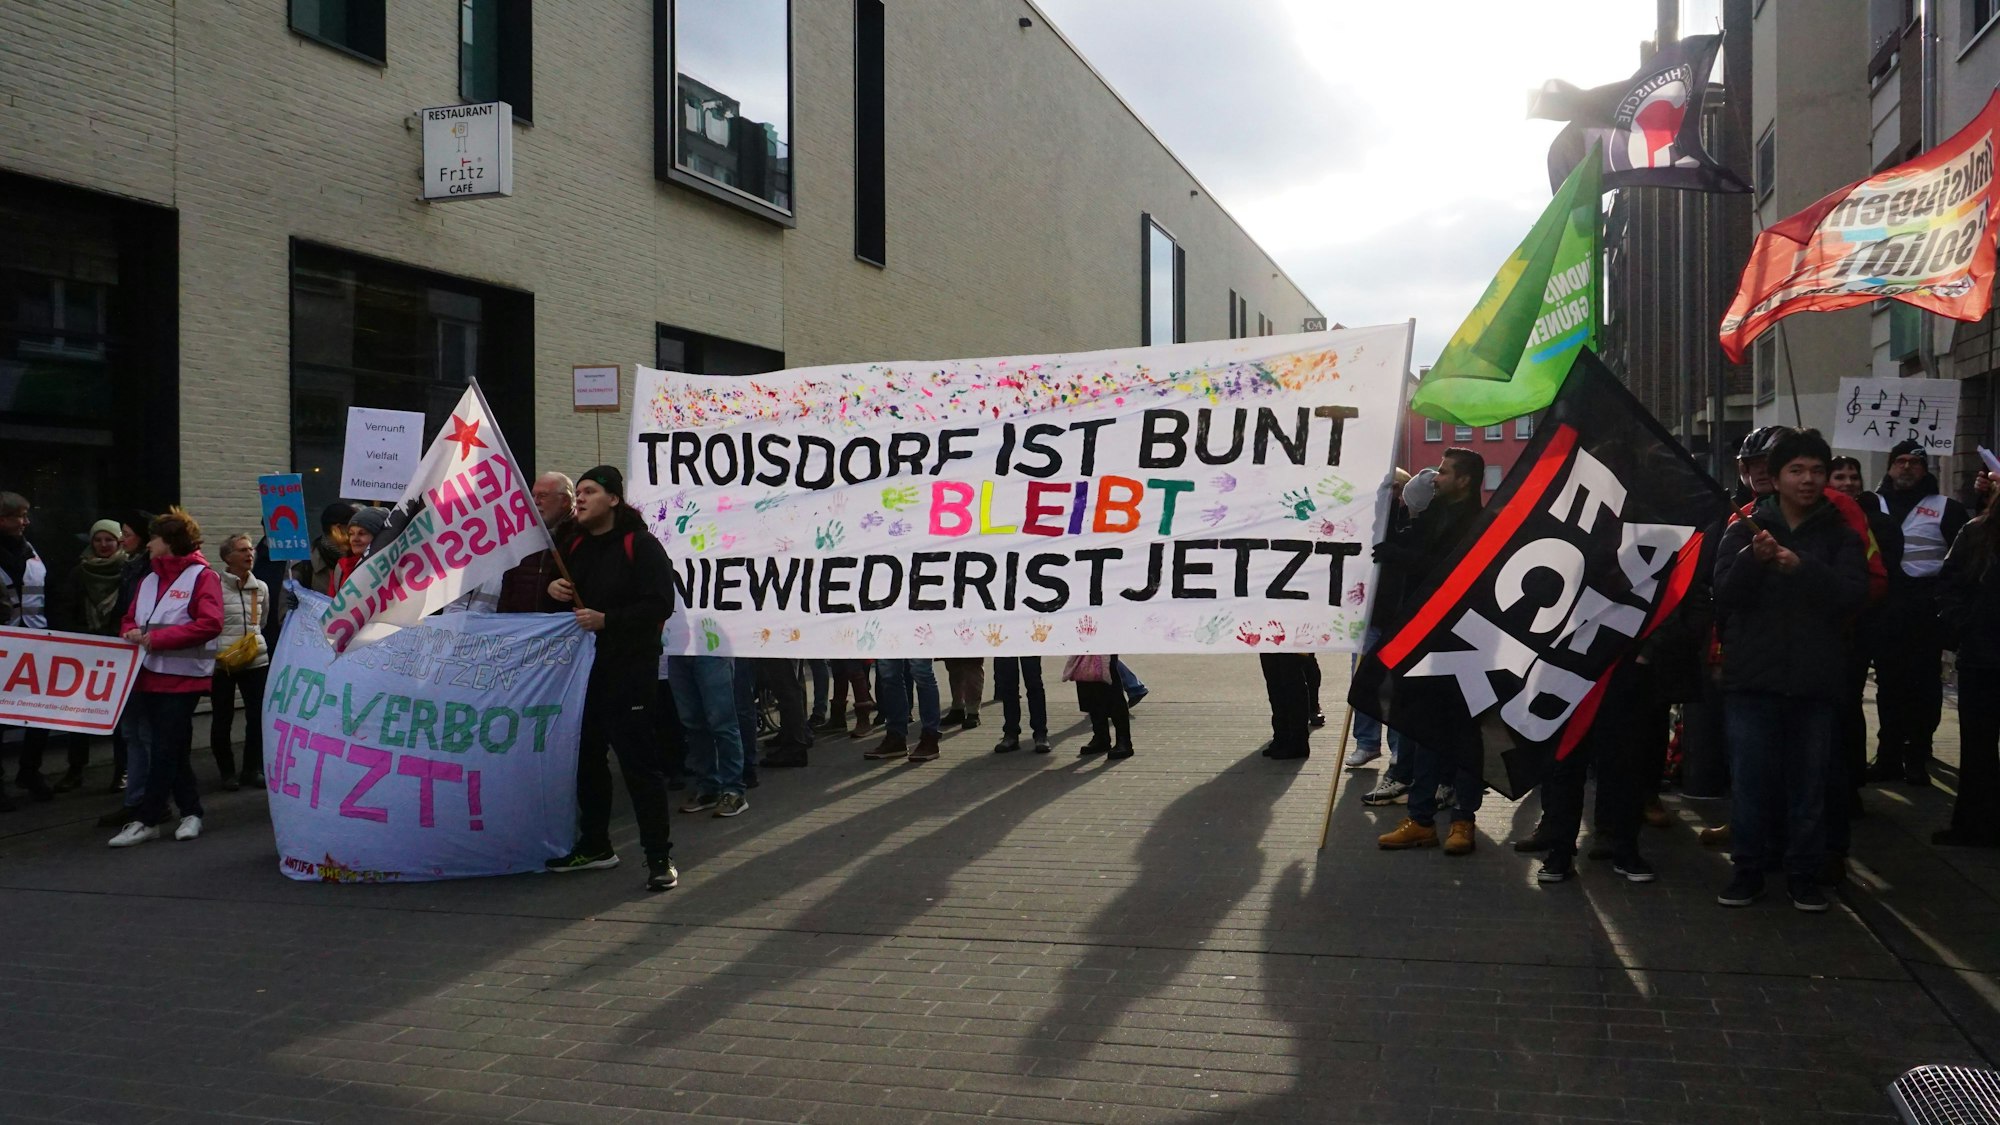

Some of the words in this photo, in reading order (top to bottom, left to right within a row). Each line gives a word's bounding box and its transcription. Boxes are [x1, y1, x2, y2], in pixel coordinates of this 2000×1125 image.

[428, 105, 493, 120] RESTAURANT
[440, 160, 484, 182] Fritz
[449, 181, 473, 194] CAFÉ
[365, 422, 405, 433] Vernunft
[1863, 420, 1880, 436] A
[1924, 434, 1952, 448] Nee
[366, 450, 398, 460] Vielfalt
[638, 428, 980, 491] TROISDORF
[995, 417, 1116, 478] IST
[1138, 406, 1359, 469] BUNT
[259, 484, 301, 496] Gegen
[350, 478, 408, 490] Miteinander
[928, 475, 1195, 537] BLEIBT
[268, 535, 307, 549] Nazis
[521, 635, 579, 667] DES
[267, 663, 562, 754] AFD-VERBOT
[267, 720, 485, 831] JETZT!
